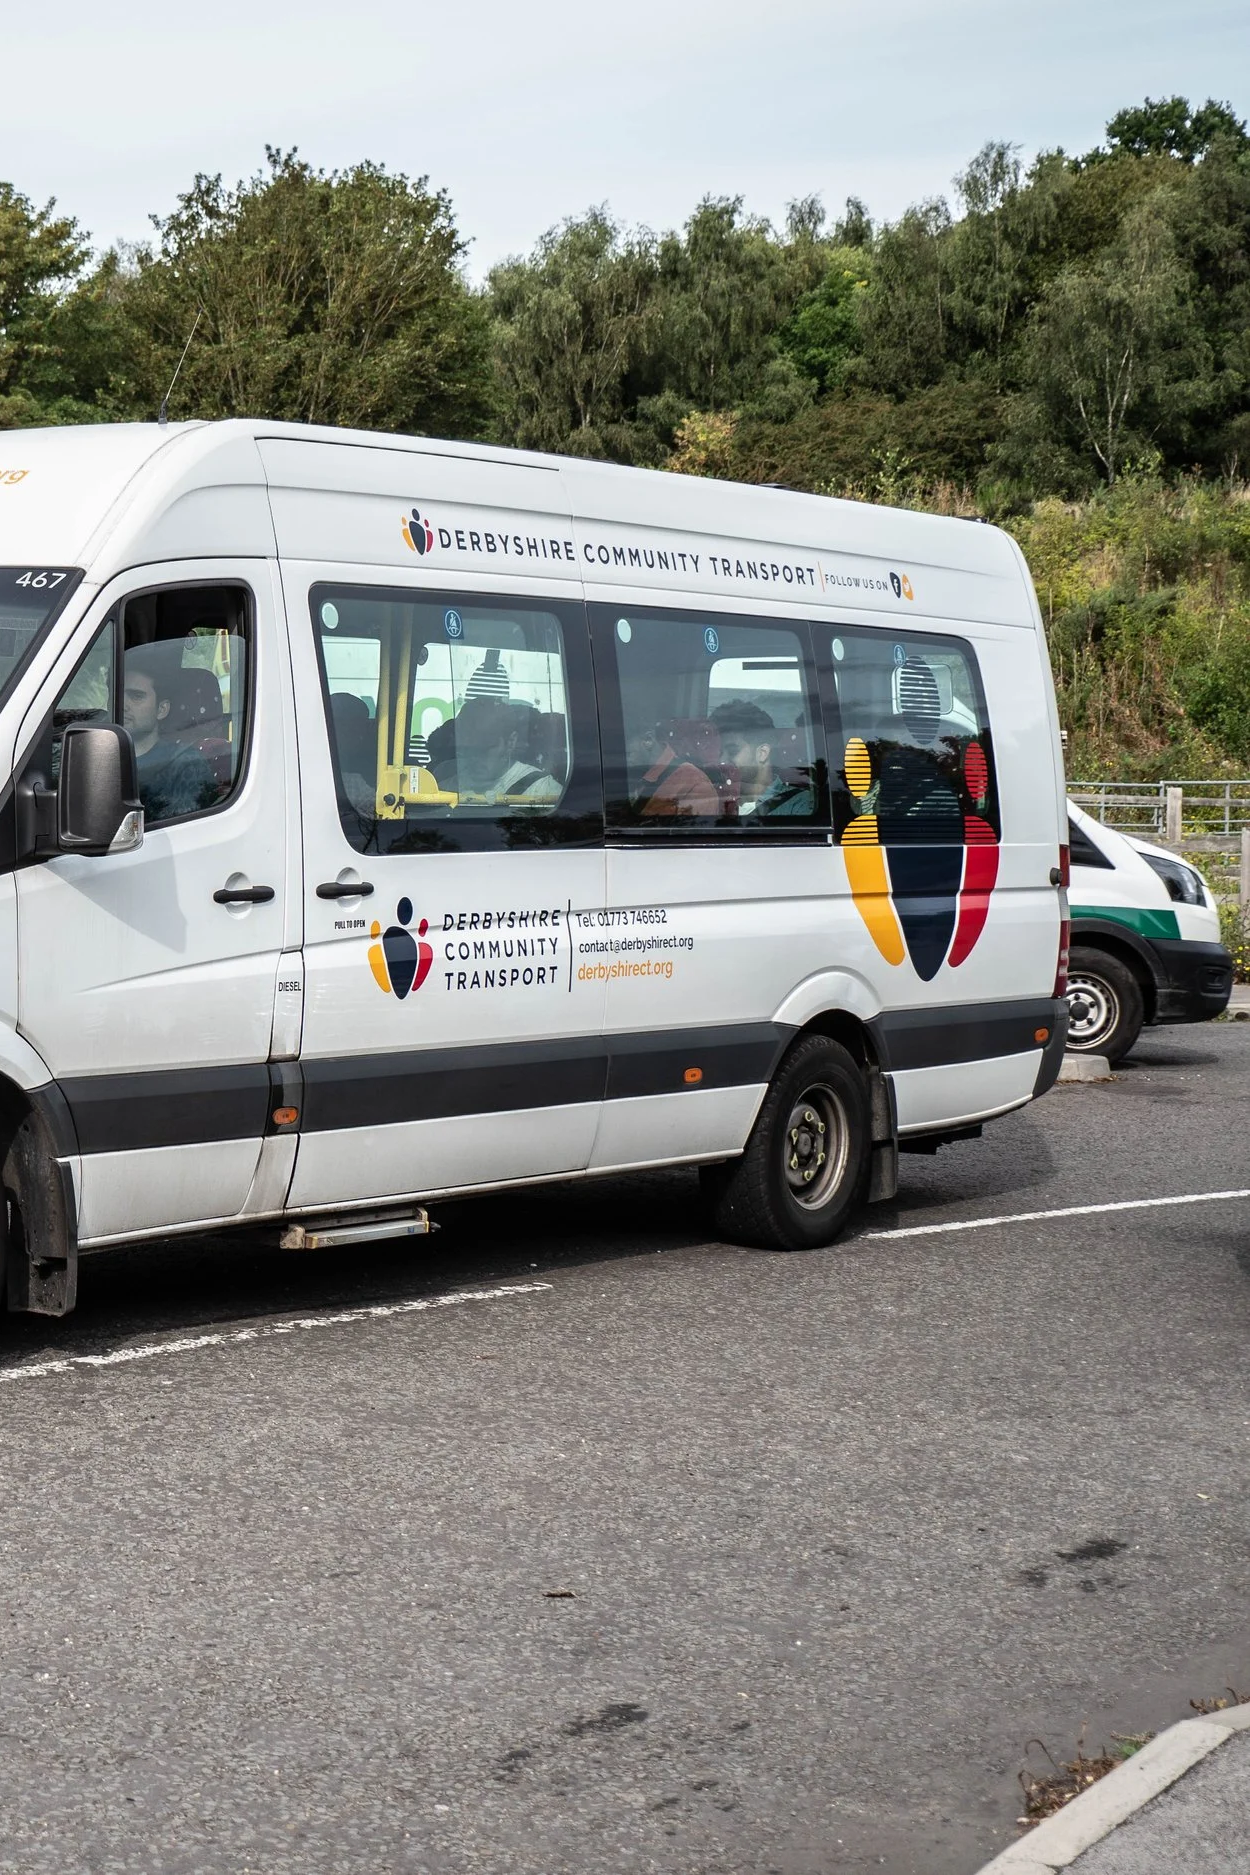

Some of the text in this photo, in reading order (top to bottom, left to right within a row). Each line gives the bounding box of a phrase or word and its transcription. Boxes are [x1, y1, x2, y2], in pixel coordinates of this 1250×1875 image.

[438, 528, 815, 586] DERBYSHIRE COMMUNITY TRANSPORT
[15, 571, 67, 589] 467
[825, 573, 888, 591] FOLLOW US ON
[334, 919, 365, 930] PULL TO OPEN
[442, 909, 561, 932] DERBYSHIRE
[575, 909, 667, 928] Tel: 01773 746652
[445, 937, 559, 961] COMMUNITY
[579, 936, 694, 954] contact@derbyshirect.org
[444, 966, 558, 990] TRANSPORT
[577, 959, 673, 983] derbyshirect.org
[278, 981, 301, 992] DIESEL
